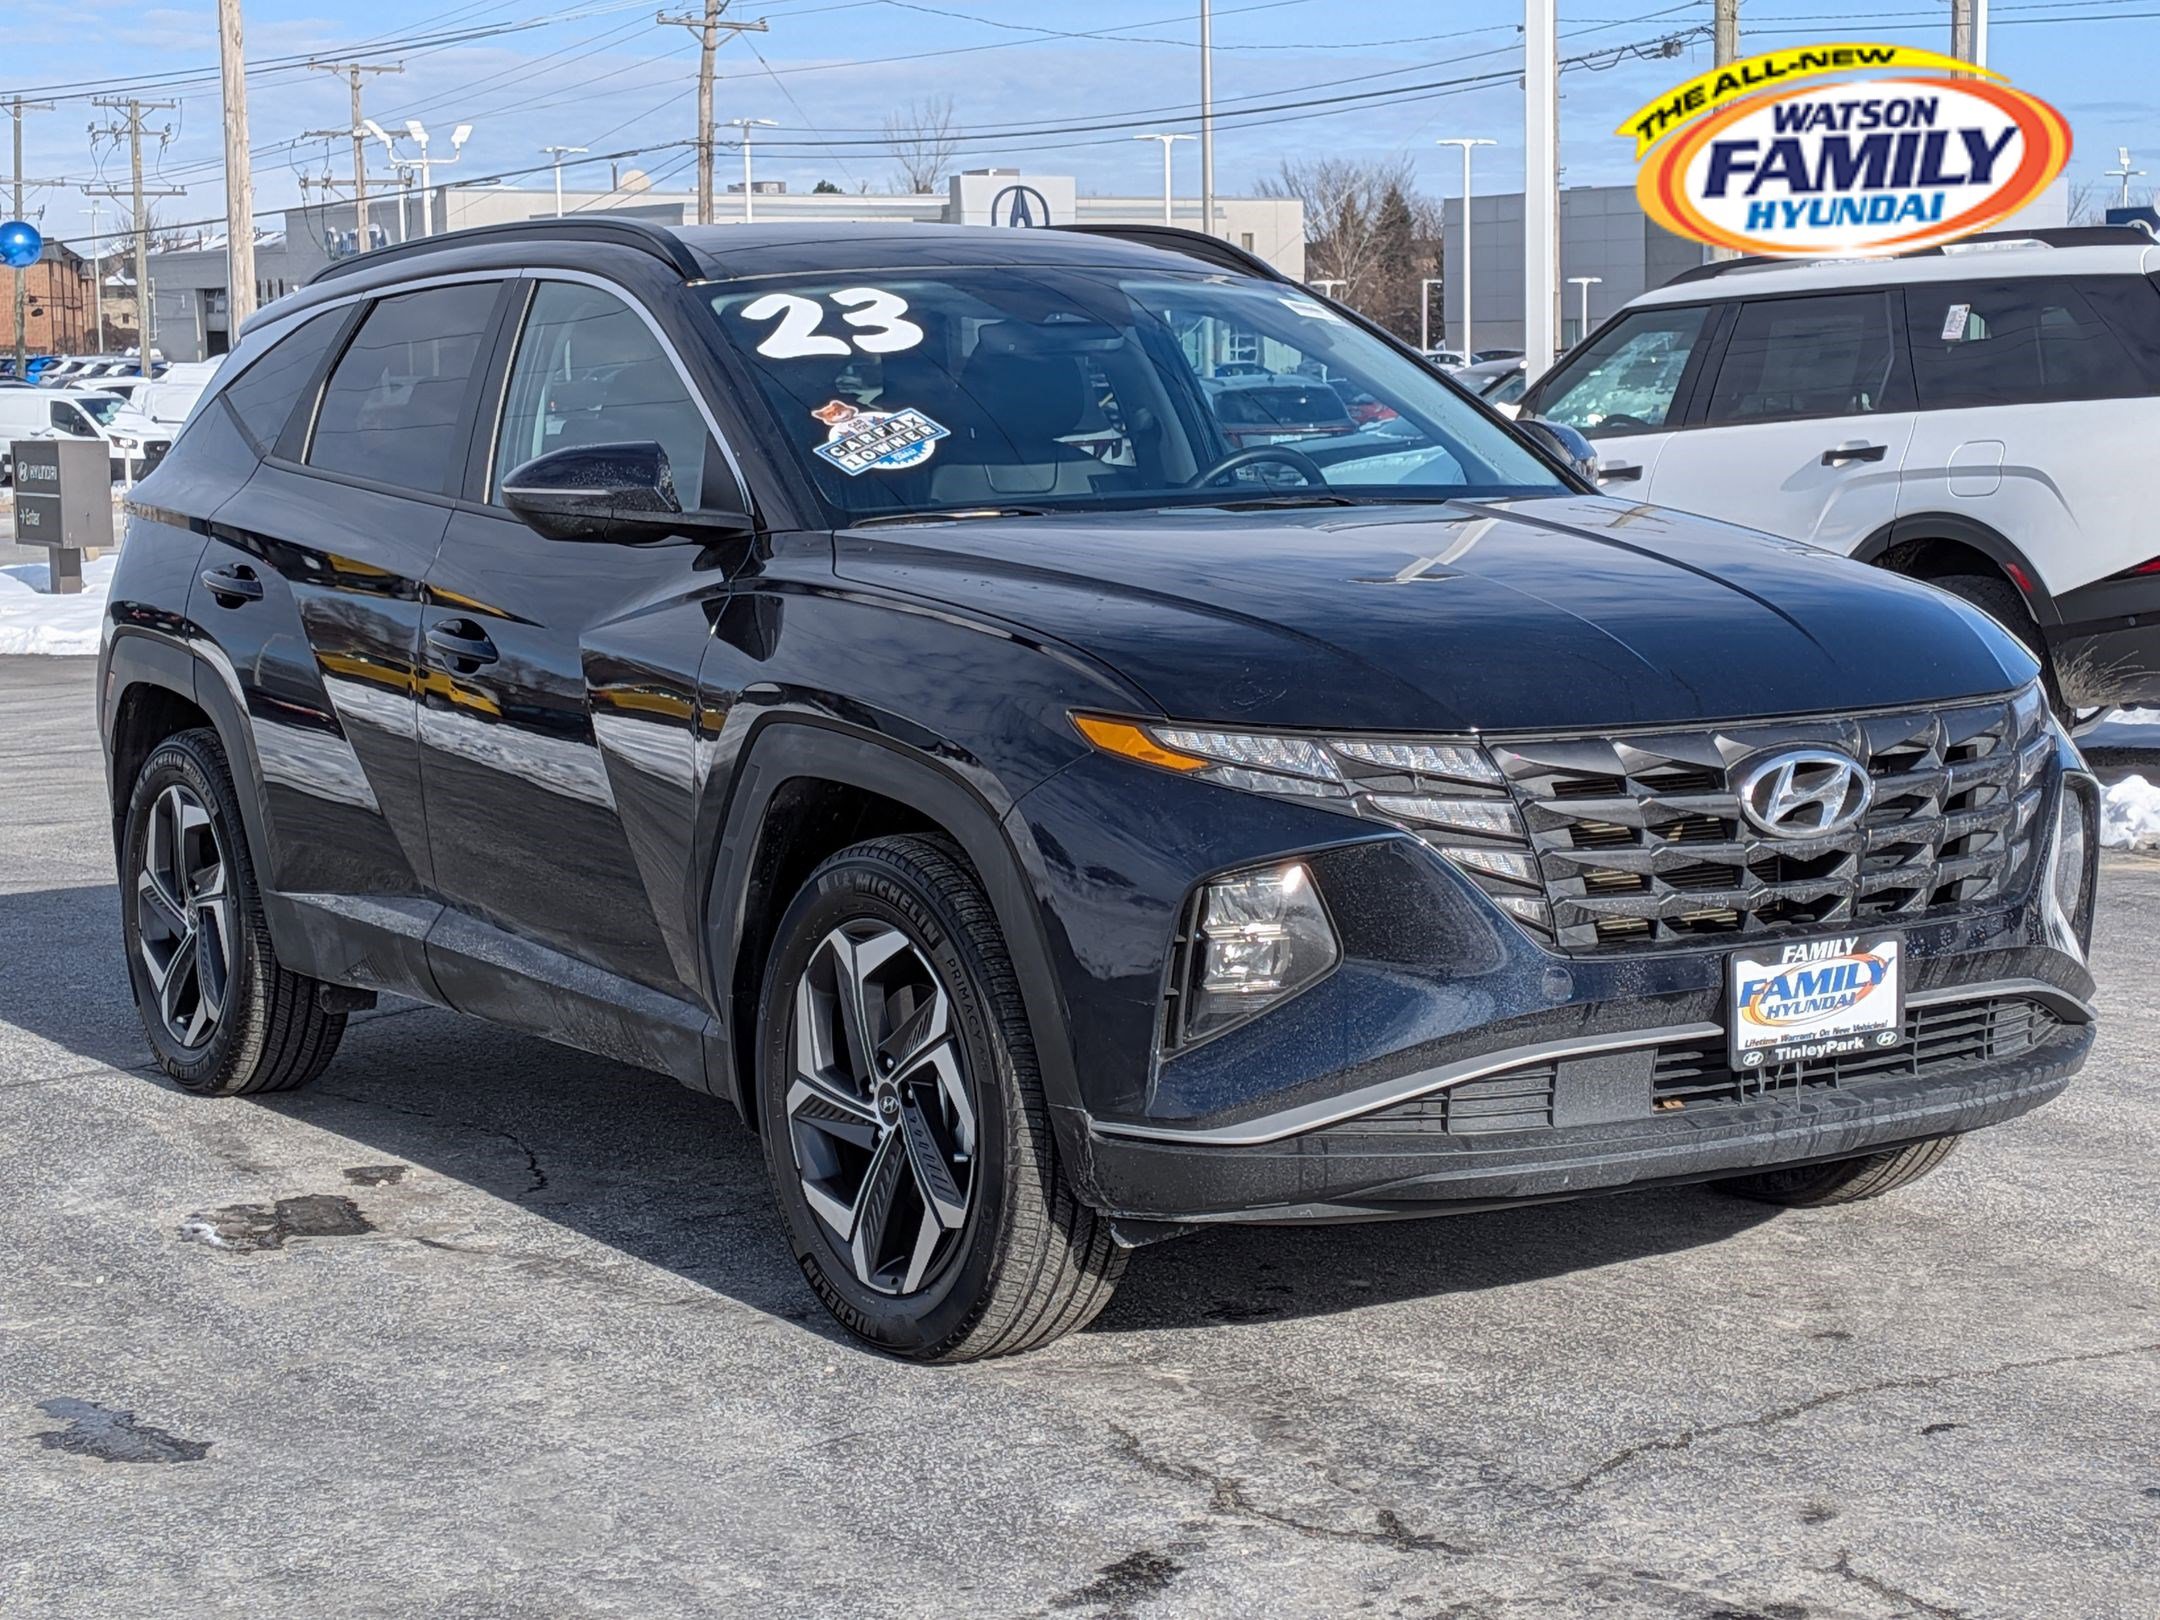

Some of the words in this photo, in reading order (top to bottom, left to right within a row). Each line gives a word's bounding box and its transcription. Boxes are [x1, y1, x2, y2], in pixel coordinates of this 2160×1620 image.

[740, 287, 924, 359] 23
[829, 416, 922, 457] CARFAX
[860, 423, 936, 461] OWNER
[855, 873, 940, 946] MICHELIN
[945, 957, 984, 1043] PRIMACY
[1780, 936, 1859, 964] FAMILY
[1737, 956, 1896, 1009] FAMILY
[1765, 991, 1857, 1020] HYUNDAI
[1744, 1037, 1778, 1048] Lifetime
[1780, 1031, 1816, 1042] Warranty
[1819, 1028, 1830, 1037] On
[1832, 1026, 1850, 1035] New
[1852, 1020, 1889, 1032] Vehicles!
[803, 1257, 879, 1338] MICHELIN
